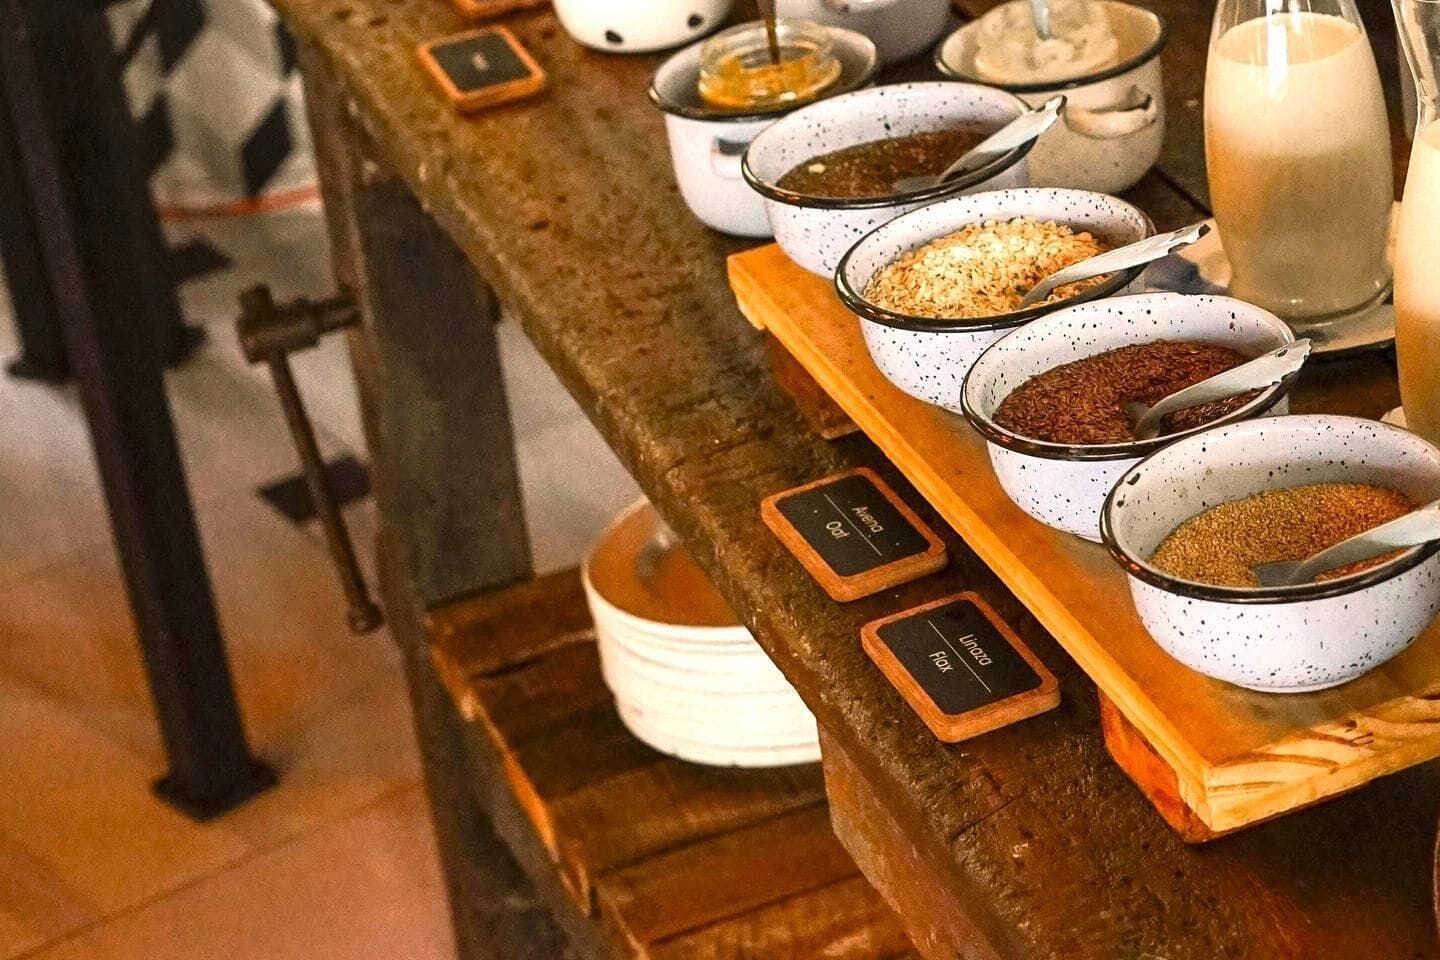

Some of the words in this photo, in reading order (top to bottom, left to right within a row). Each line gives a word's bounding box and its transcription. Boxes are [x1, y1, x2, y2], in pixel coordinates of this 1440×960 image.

[825, 520, 850, 539] Oat
[851, 505, 885, 534] Avena
[928, 650, 953, 673] Flax
[959, 633, 993, 667] Linaza
